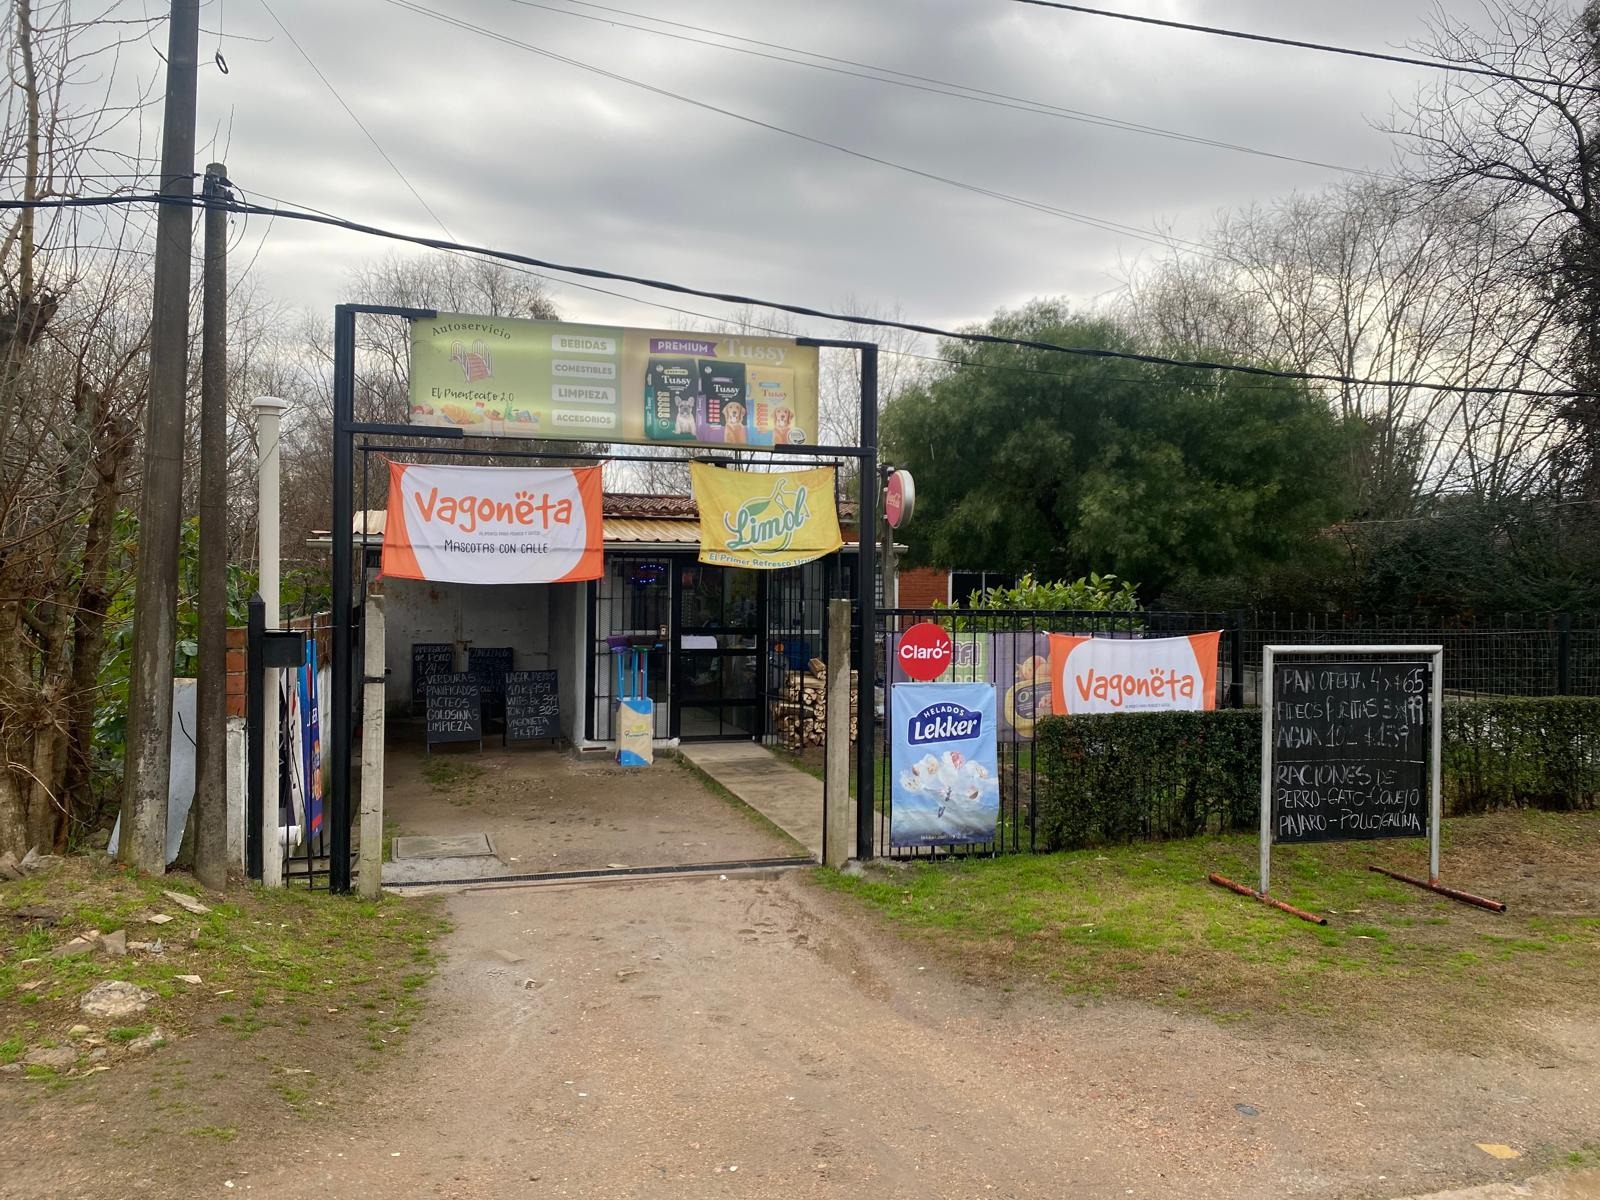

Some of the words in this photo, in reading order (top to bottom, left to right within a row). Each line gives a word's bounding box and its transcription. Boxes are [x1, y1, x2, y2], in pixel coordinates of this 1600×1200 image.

[431, 321, 511, 341] Autoservicio
[560, 338, 608, 351] BEBIDAS
[657, 341, 708, 353] PREMIUM
[722, 337, 788, 366] Tussy
[554, 363, 613, 375] COMESTIBLES
[661, 375, 691, 388] Tussy
[431, 387, 442, 399] El
[558, 388, 609, 400] LIMPIEZA
[713, 384, 740, 398] Tussy
[556, 414, 612, 425] ACCESORIOS
[444, 539, 495, 554] MASCOTAS
[499, 543, 517, 554] CON
[521, 543, 549, 554] CALLE
[709, 553, 719, 561] El
[720, 555, 750, 566] Primer
[752, 558, 792, 568] Refresco
[426, 673, 476, 684] VERDURAS
[1282, 669, 1315, 694] PAN
[426, 685, 478, 696] PANIFICADOS
[426, 697, 470, 708] LACTEOS
[923, 706, 965, 719] HELADOS
[427, 721, 474, 732] LIMPIEZA
[914, 717, 978, 741] Lekker
[1277, 725, 1322, 749] AGUA
[1276, 764, 1372, 787] RACIONES
[1376, 768, 1398, 786] DE
[1279, 813, 1327, 837] PAJARO
